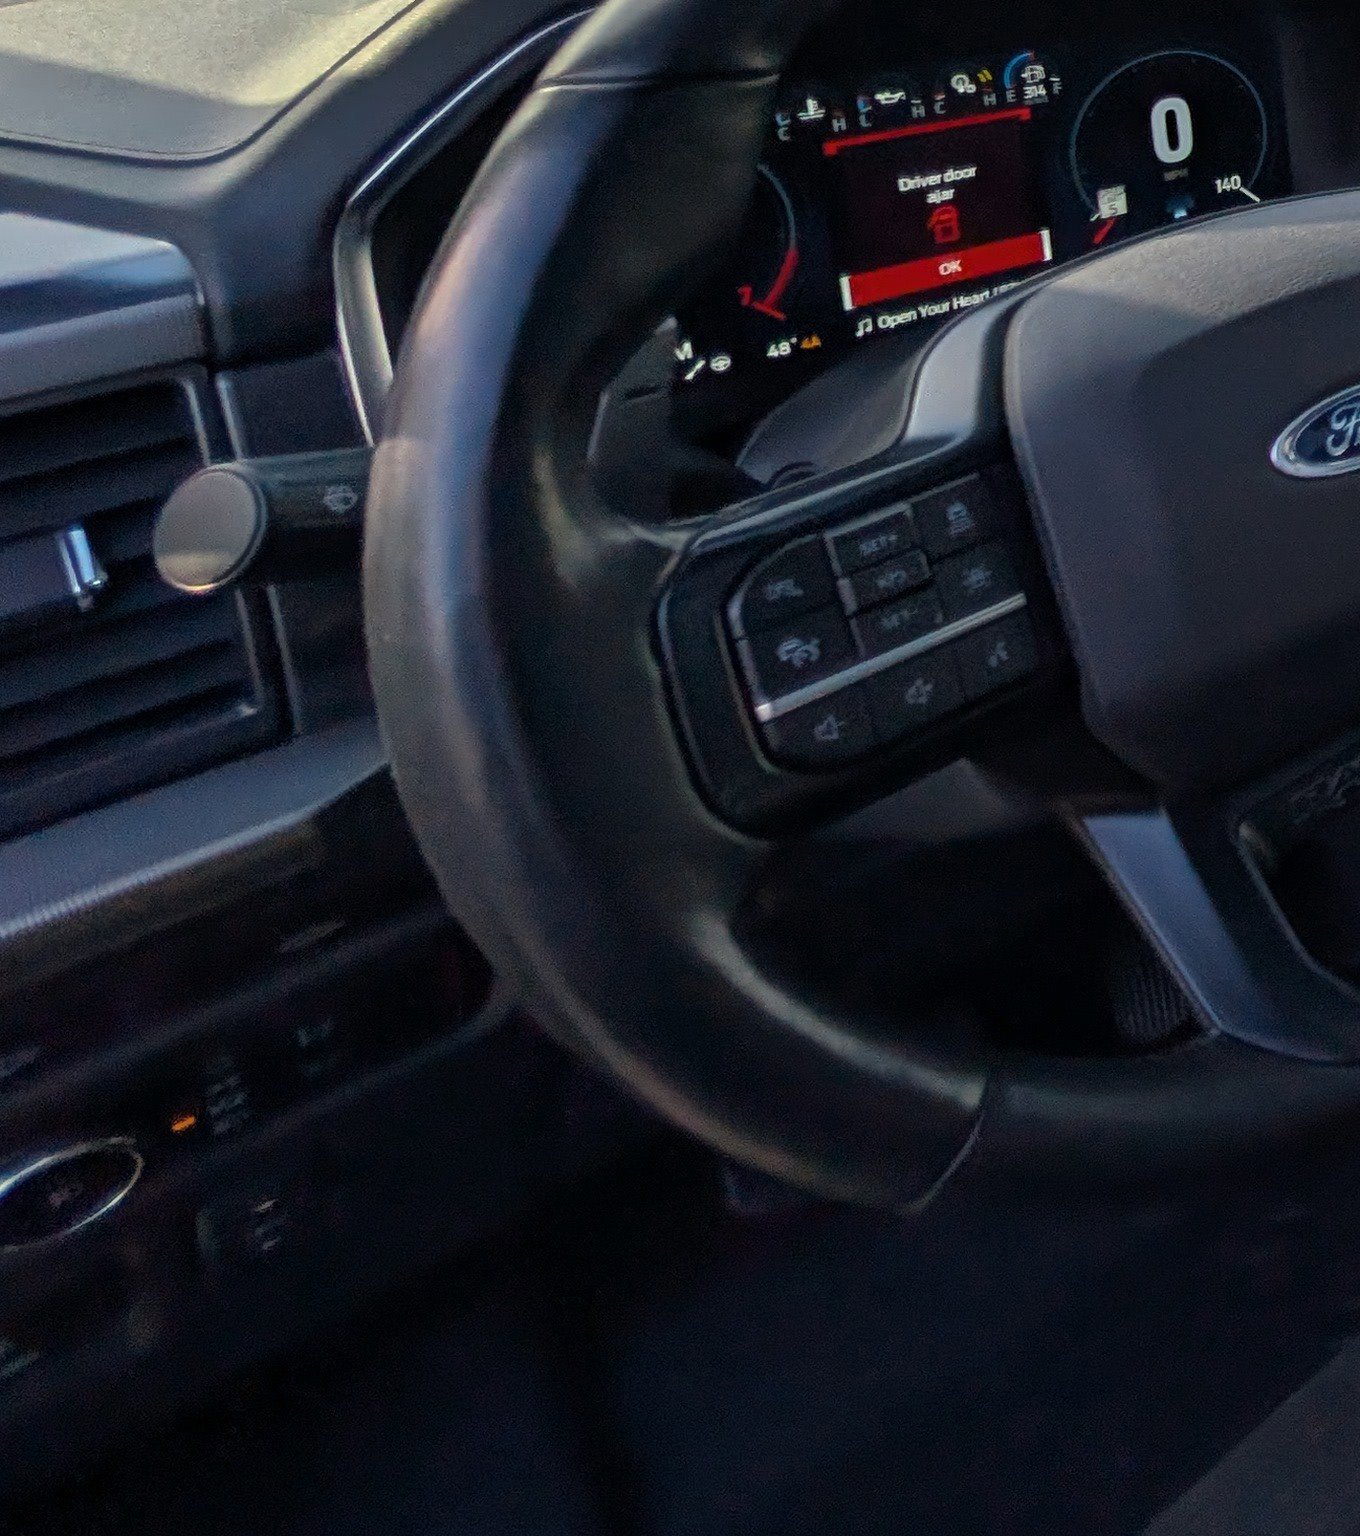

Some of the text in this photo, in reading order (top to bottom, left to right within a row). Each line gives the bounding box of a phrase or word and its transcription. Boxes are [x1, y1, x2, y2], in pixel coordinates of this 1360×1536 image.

[1023, 85, 1048, 100] 314
[1151, 96, 1194, 164] 0
[897, 166, 977, 192] Driver door
[1215, 175, 1242, 194] 140
[926, 188, 955, 204] ajar
[938, 259, 962, 276] OK
[878, 310, 917, 328] Open
[918, 299, 951, 318] Your
[766, 336, 798, 358] 48°
